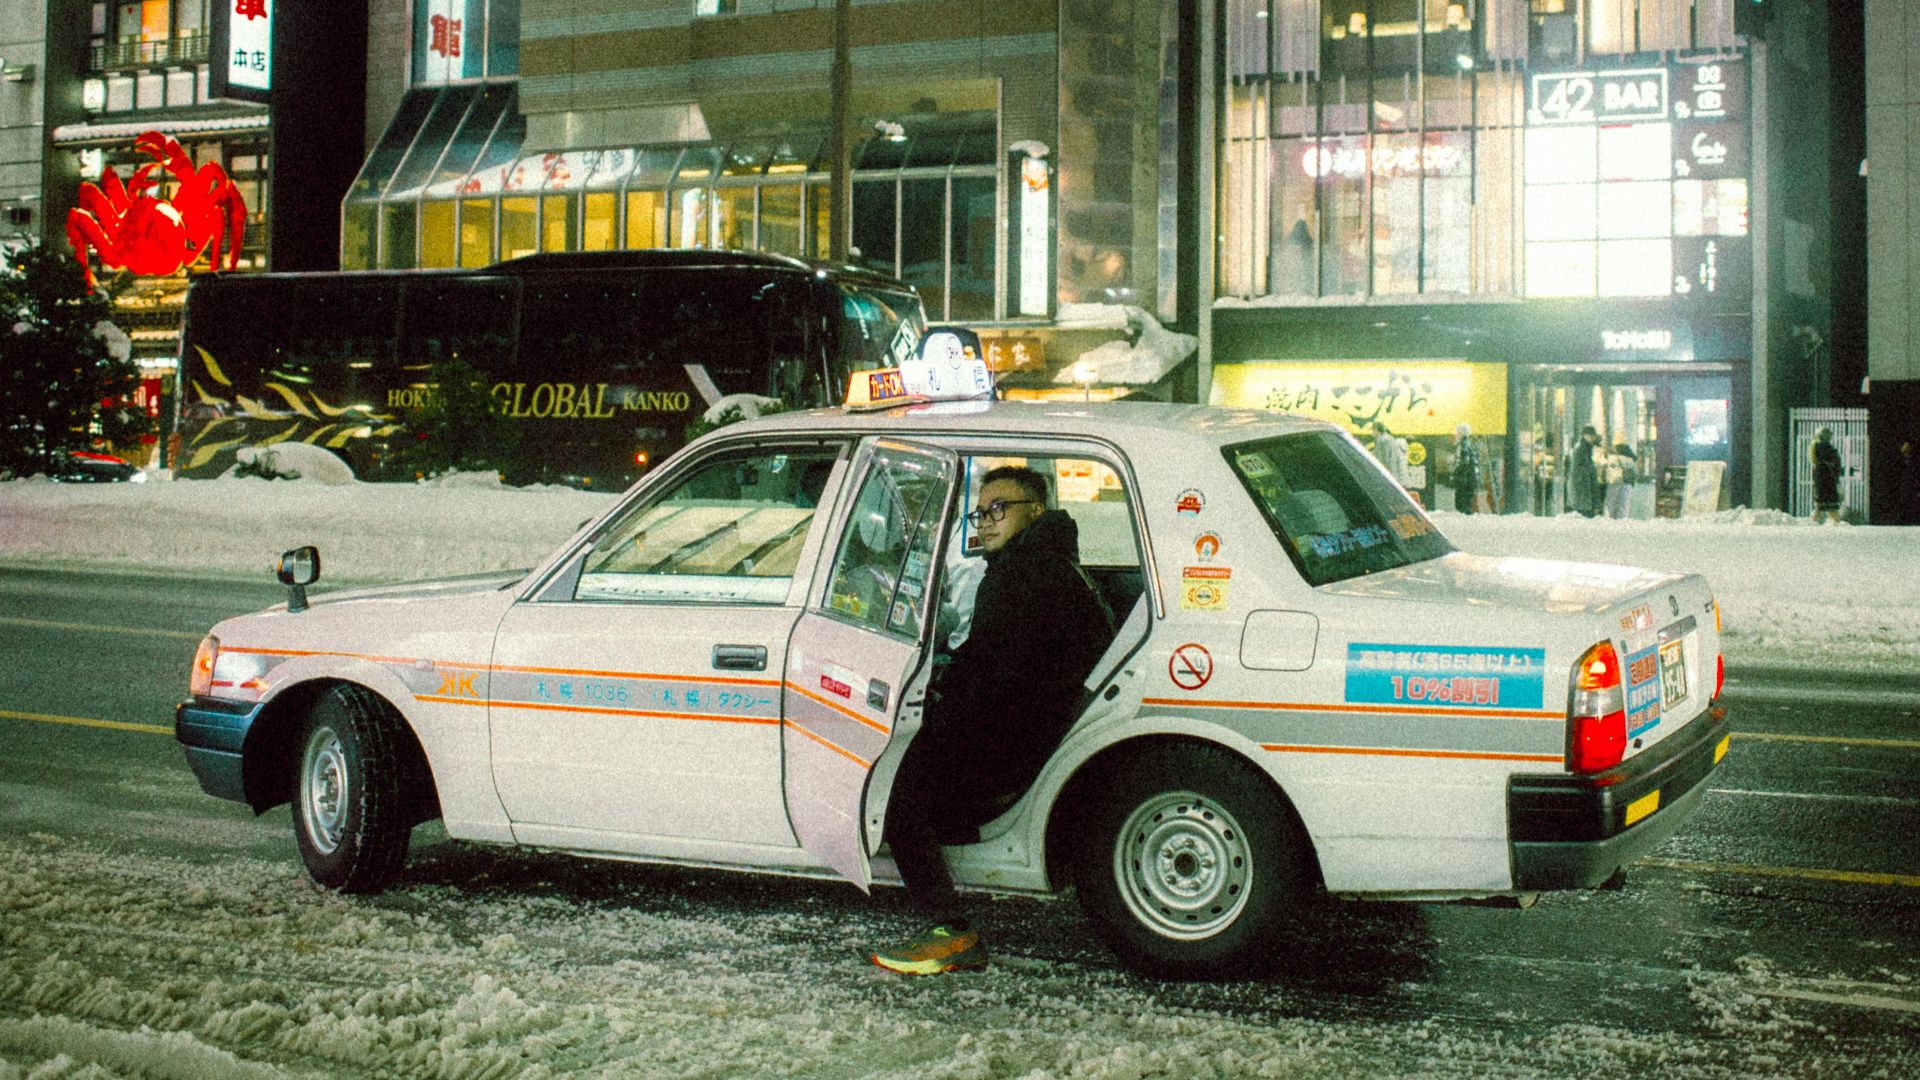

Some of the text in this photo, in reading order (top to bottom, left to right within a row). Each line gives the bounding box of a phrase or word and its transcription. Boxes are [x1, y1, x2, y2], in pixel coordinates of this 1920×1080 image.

[232, 48, 266, 71] 本店
[1543, 78, 1594, 119] 42
[1603, 80, 1659, 110] BAR
[489, 383, 617, 418] GLOBAL
[622, 391, 690, 412] KANKO
[584, 683, 628, 702] 1036
